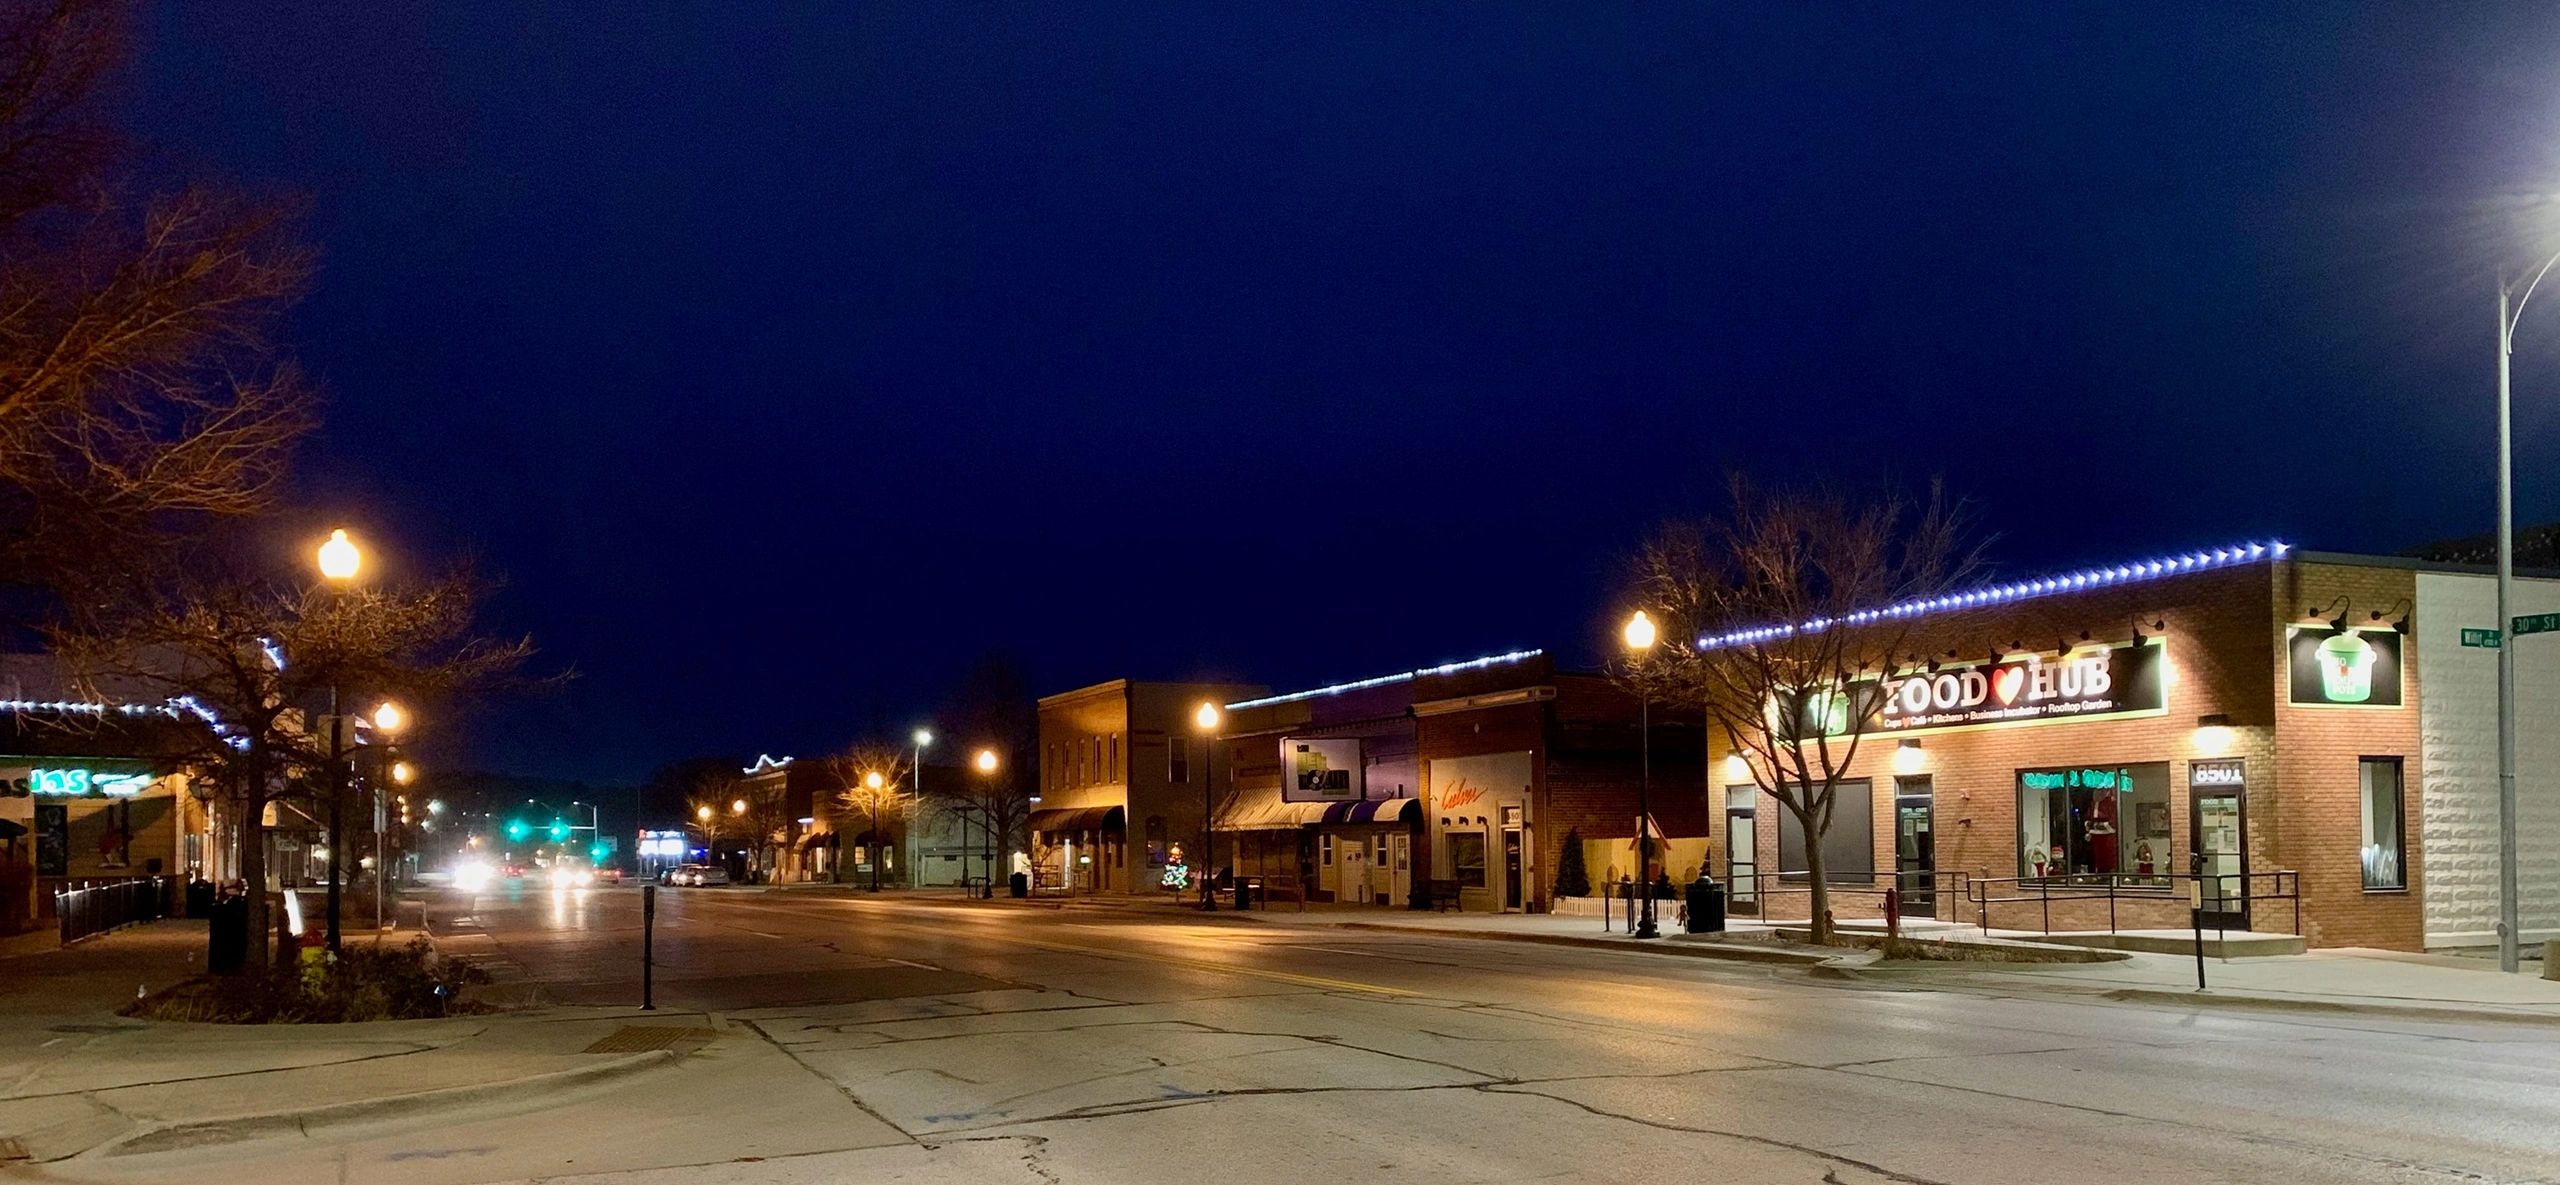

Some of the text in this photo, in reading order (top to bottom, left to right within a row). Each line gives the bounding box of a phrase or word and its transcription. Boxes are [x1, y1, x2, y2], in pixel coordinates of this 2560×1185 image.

[2544, 616, 2555, 630] St
[1883, 656, 2113, 714] FOOD HUB
[1932, 713, 1964, 724] Kitchens
[1969, 709, 2003, 721] Business
[2003, 705, 2041, 718] Incubator
[2048, 702, 2081, 714] Rooftop
[2081, 698, 2113, 711] Garden
[2196, 764, 2244, 783] 8501
